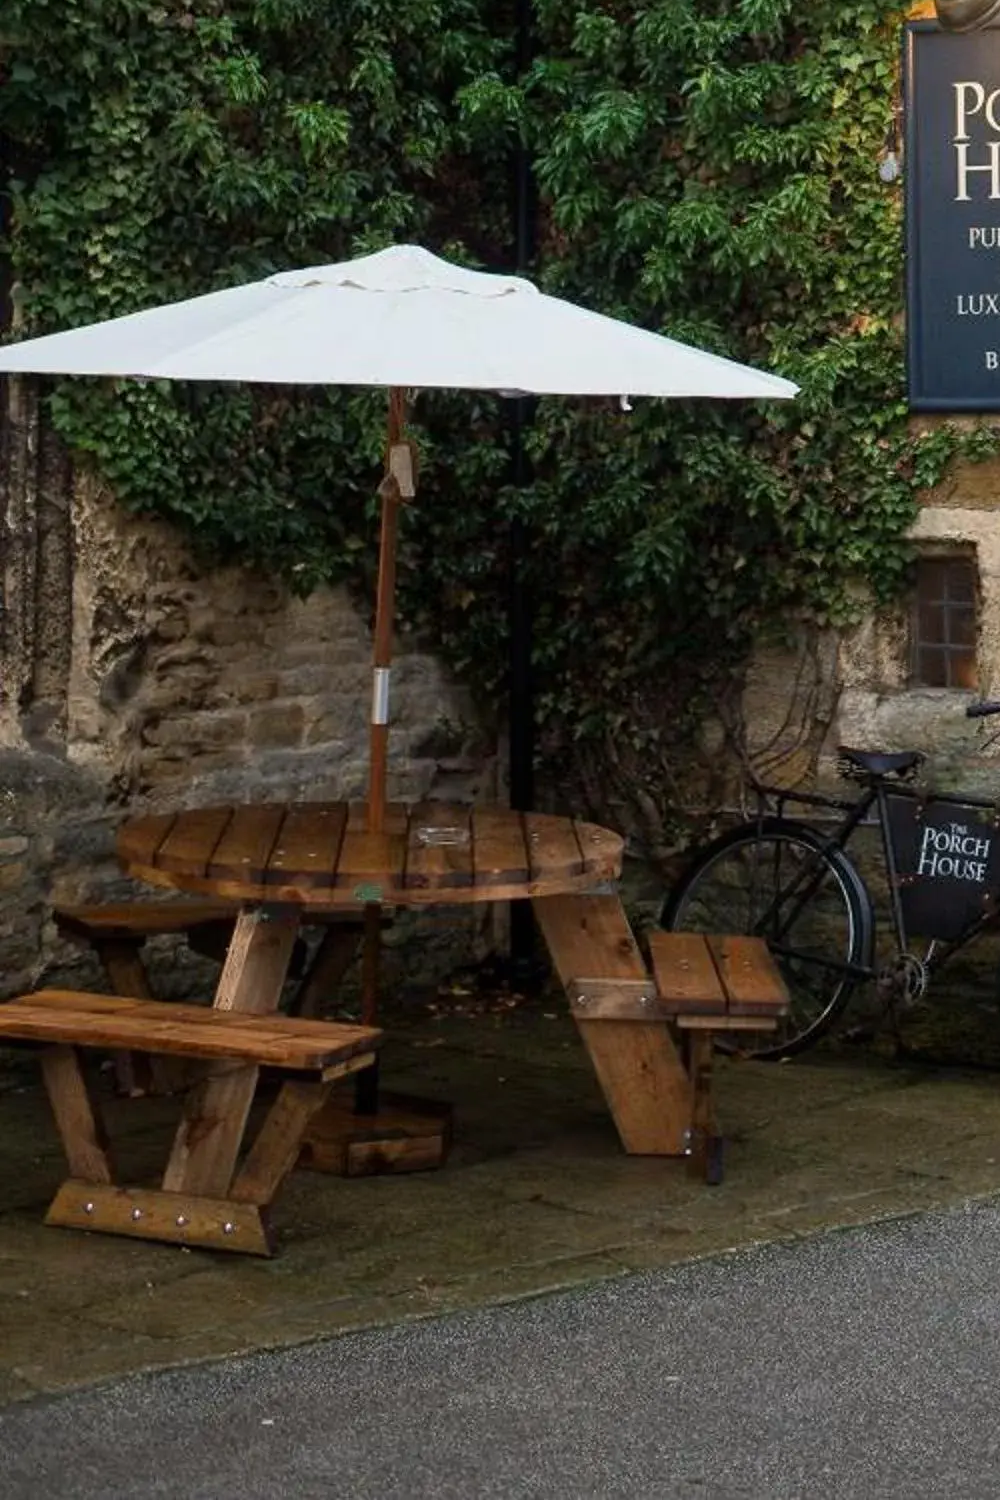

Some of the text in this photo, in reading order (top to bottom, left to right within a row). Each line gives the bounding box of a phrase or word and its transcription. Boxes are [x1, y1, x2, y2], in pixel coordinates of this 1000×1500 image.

[922, 827, 991, 858] PORCH
[950, 823, 968, 835] THE
[917, 851, 987, 883] HOUSE
